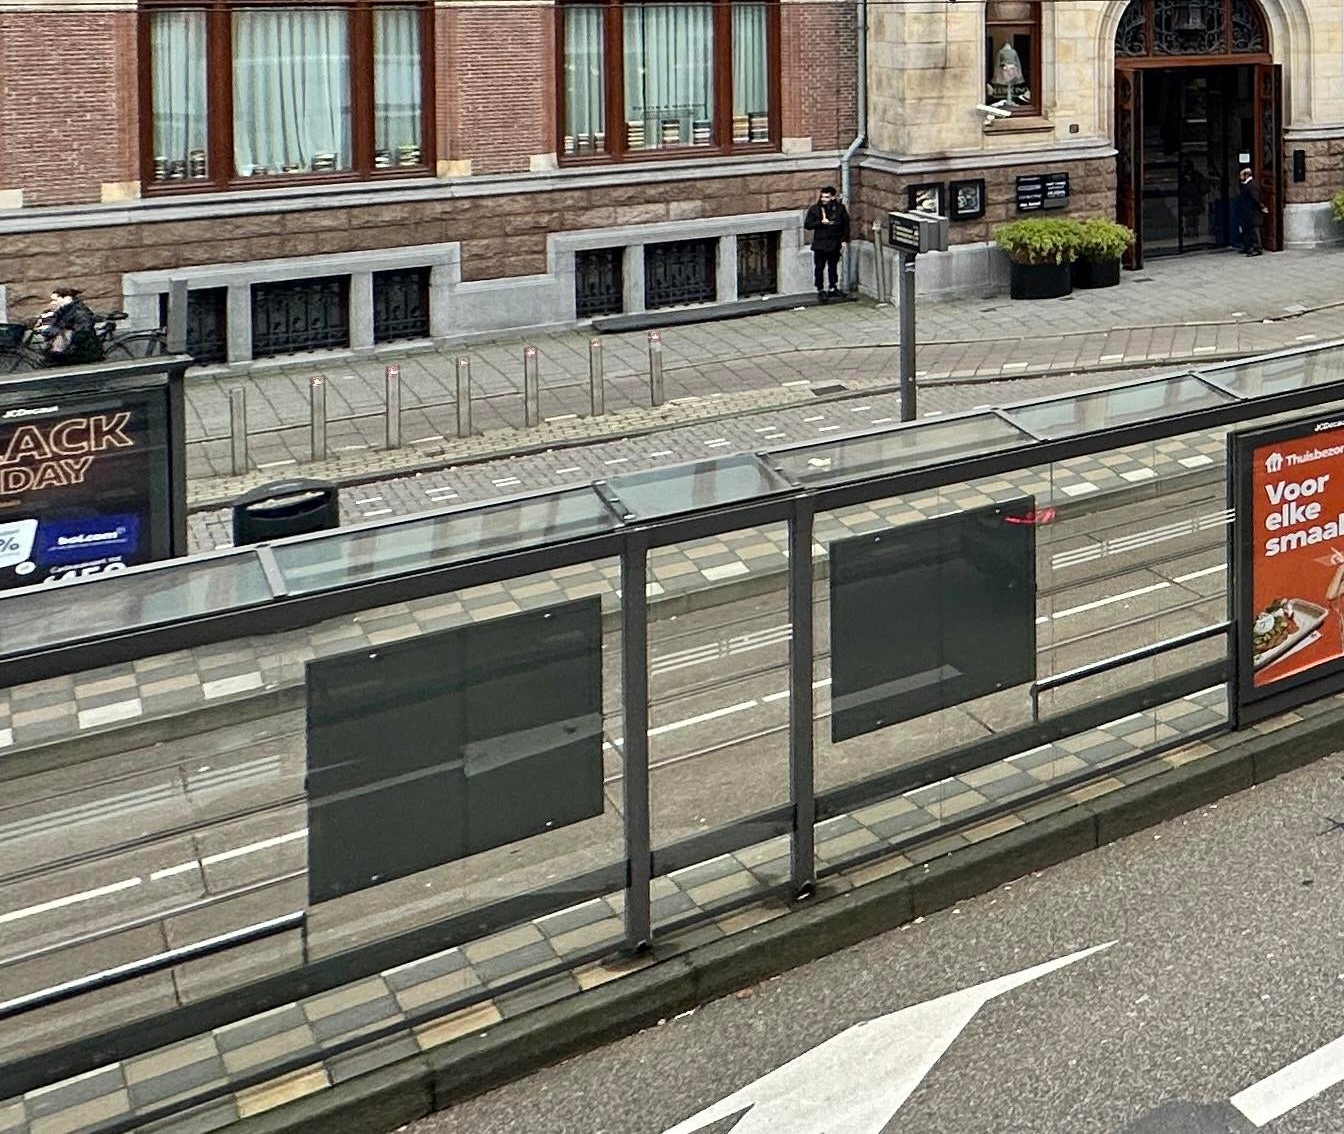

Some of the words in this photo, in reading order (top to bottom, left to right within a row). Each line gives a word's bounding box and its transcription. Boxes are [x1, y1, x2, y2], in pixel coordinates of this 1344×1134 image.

[0, 412, 134, 464] ACK
[1264, 473, 1330, 506] Voor
[1264, 501, 1322, 532] elke
